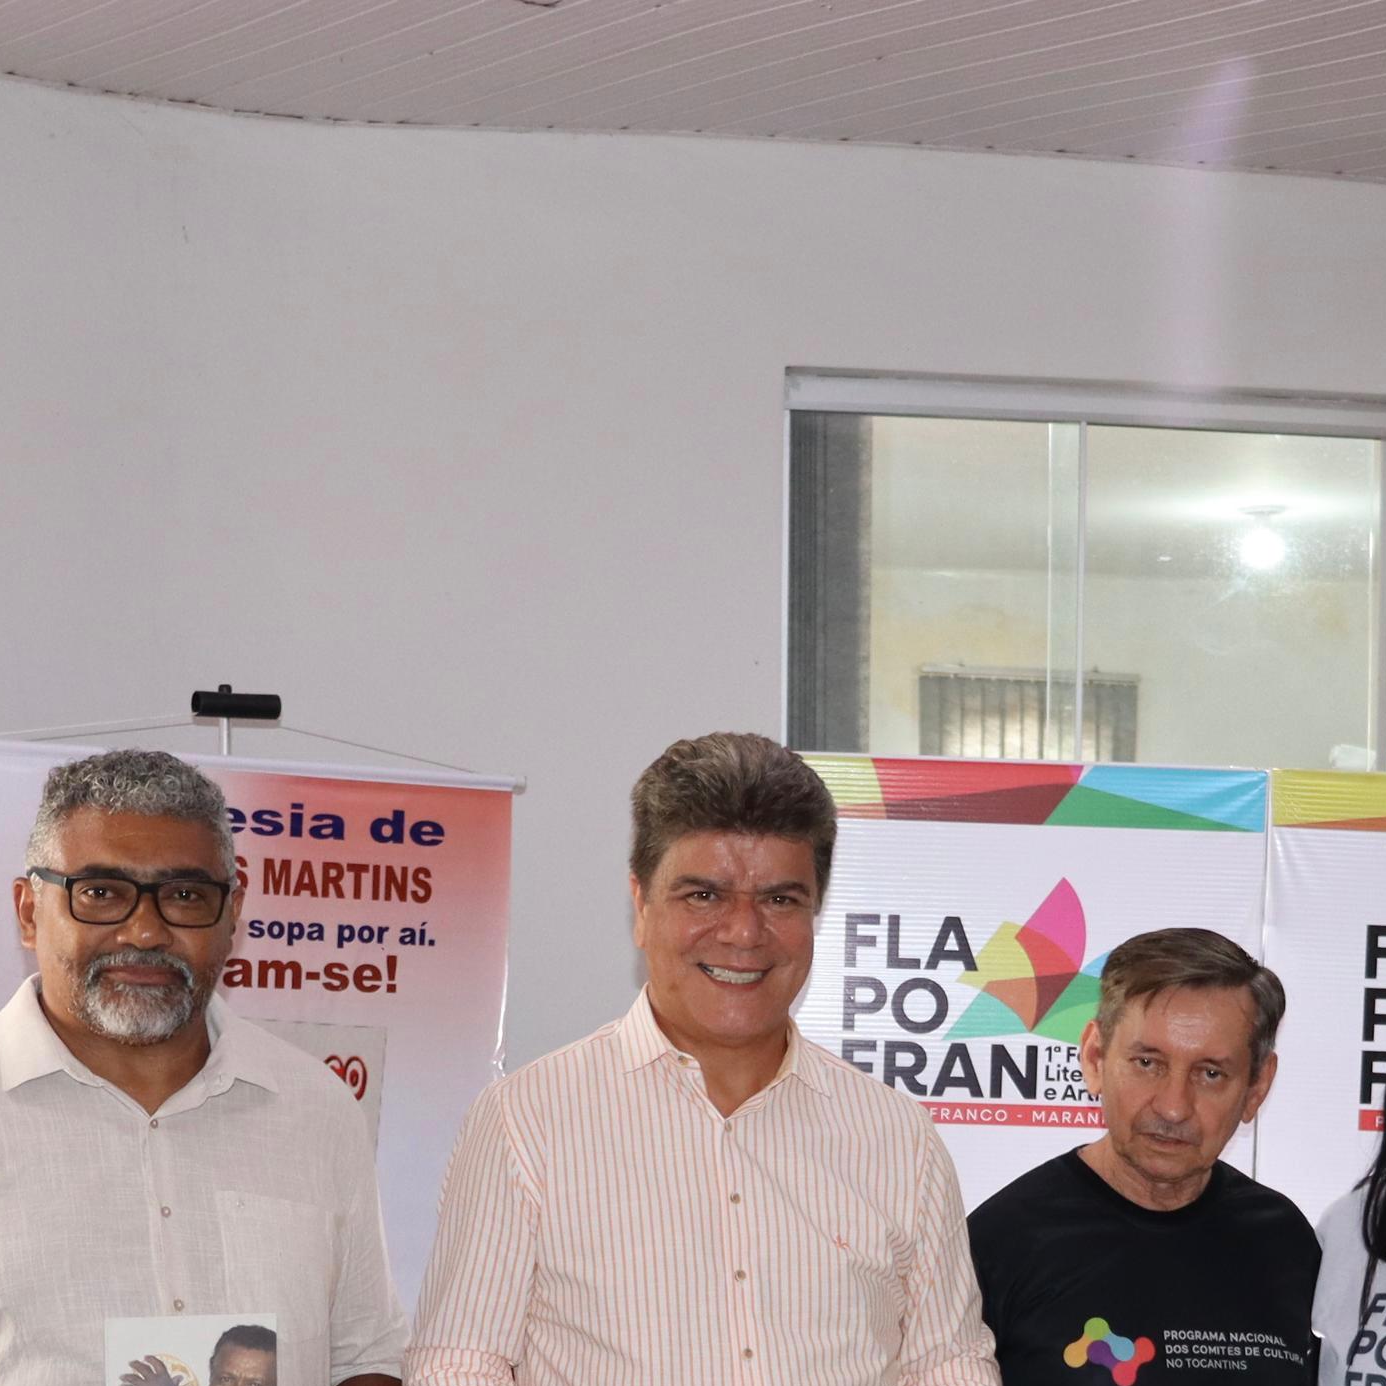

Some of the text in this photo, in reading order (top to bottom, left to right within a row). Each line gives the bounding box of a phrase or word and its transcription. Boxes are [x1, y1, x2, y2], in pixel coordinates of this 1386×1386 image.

[225, 803, 445, 847] esia de
[263, 858, 433, 904] MARTINS
[248, 919, 436, 949] sopa por aí.
[844, 913, 978, 972] FLA
[223, 955, 398, 994] am-se!
[842, 975, 949, 1034] PO
[1067, 1047, 1081, 1063] F
[842, 1039, 1039, 1099] FRAN
[1045, 1064, 1084, 1082] Lite
[1044, 1088, 1057, 1101] e
[930, 1108, 1008, 1122] FRANCO
[1032, 1110, 1105, 1125] MARAN
[1163, 1330, 1287, 1347] PROGRAMA NACIONAL
[1165, 1345, 1189, 1354] DOS
[1245, 1347, 1261, 1356] DE
[1263, 1348, 1304, 1365] CULTURA
[1166, 1359, 1247, 1370] NO TOCANTINS
